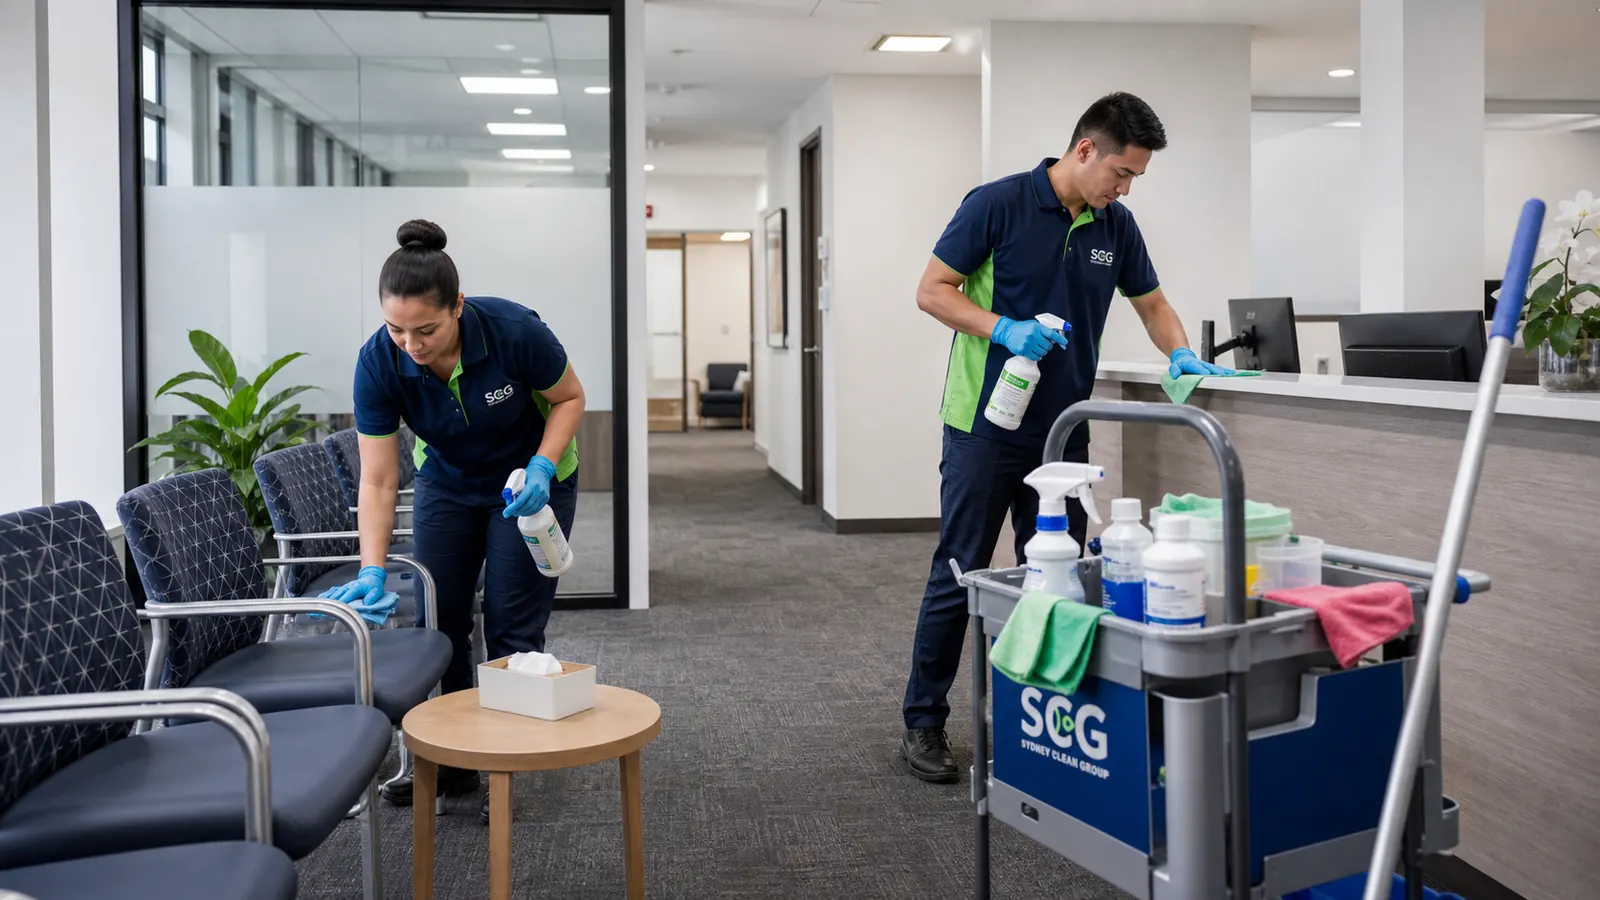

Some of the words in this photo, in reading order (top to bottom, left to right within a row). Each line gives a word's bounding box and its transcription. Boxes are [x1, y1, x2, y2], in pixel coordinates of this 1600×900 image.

[1090, 248, 1113, 263] SCG
[485, 384, 513, 403] SCG
[1021, 686, 1108, 761] SCG
[1020, 738, 1051, 758] SYDNEY
[1051, 749, 1079, 769] CLEAN
[1079, 760, 1110, 780] GROUP
